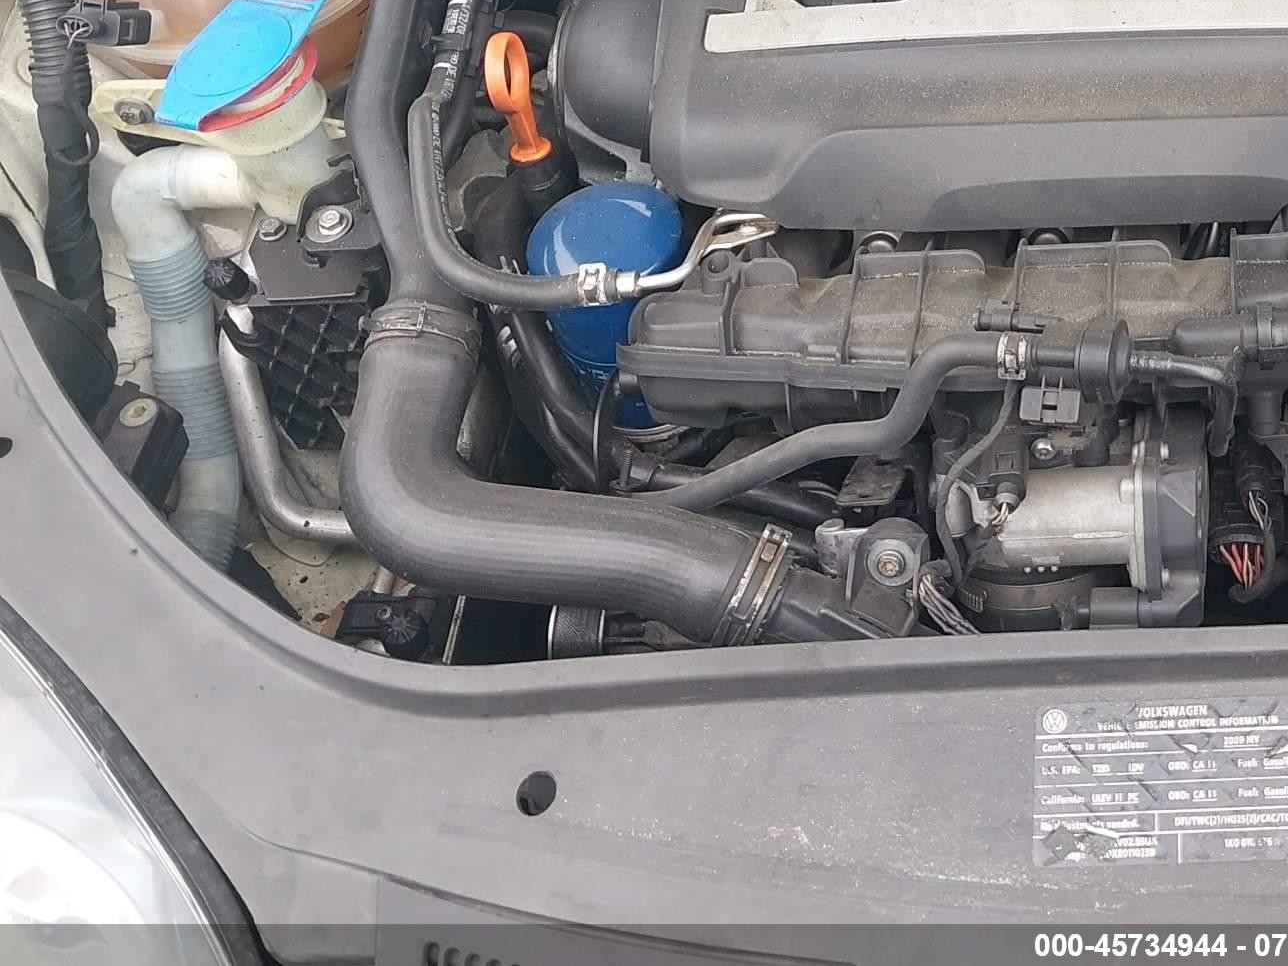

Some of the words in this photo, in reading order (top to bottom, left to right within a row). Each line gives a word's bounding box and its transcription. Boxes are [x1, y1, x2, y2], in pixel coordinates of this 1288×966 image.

[1097, 721, 1131, 731] VEHICE
[1177, 717, 1216, 728] CONTROL
[1085, 742, 1095, 751] to
[1098, 740, 1149, 752] regulations:
[1223, 735, 1245, 745] 2009
